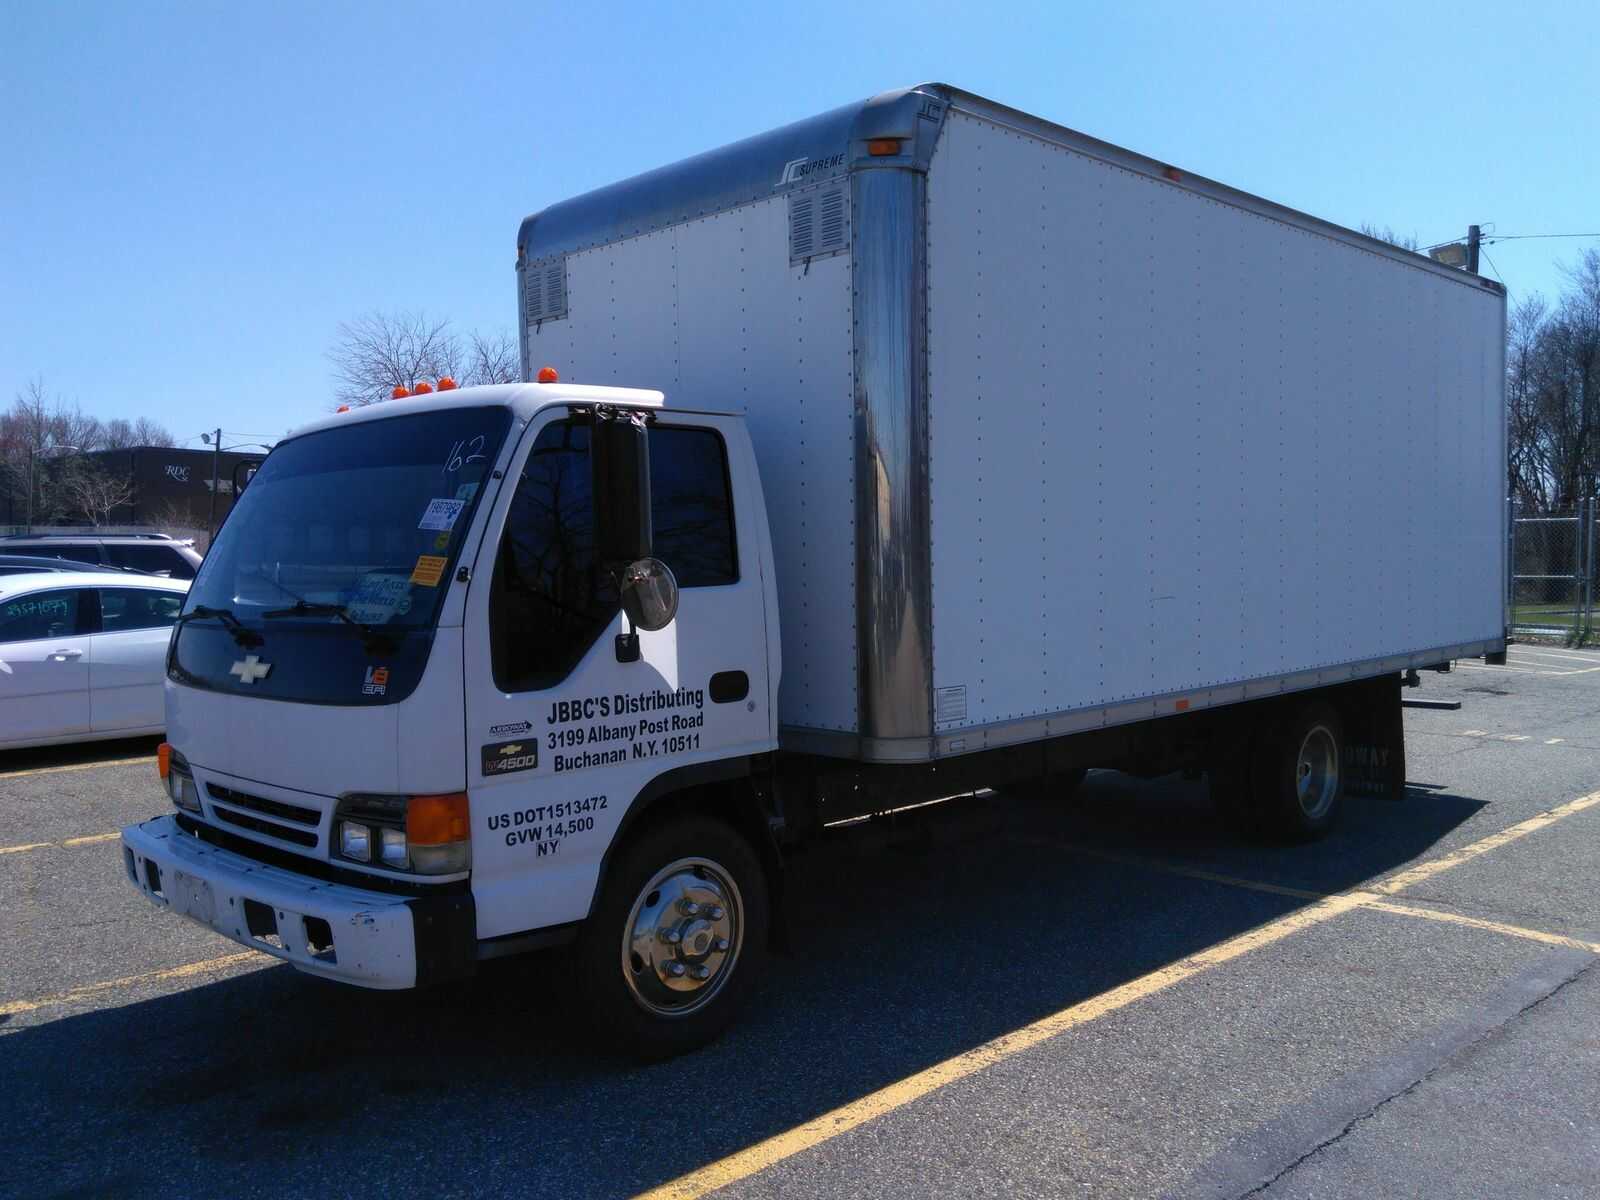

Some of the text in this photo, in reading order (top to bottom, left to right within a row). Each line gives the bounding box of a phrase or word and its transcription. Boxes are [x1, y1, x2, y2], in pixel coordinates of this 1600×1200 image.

[800, 154, 845, 176] SUPREME
[442, 435, 487, 473] 162
[165, 464, 190, 481] RDC
[547, 687, 704, 725] JBBC'S Distributing
[547, 712, 704, 750] 3199 Albany Post Road
[554, 734, 701, 772] Buchanan N.Y. 10511
[487, 795, 608, 831] US DOT1513472
[505, 816, 594, 847] GVW 14,500
[537, 840, 560, 857] NY
